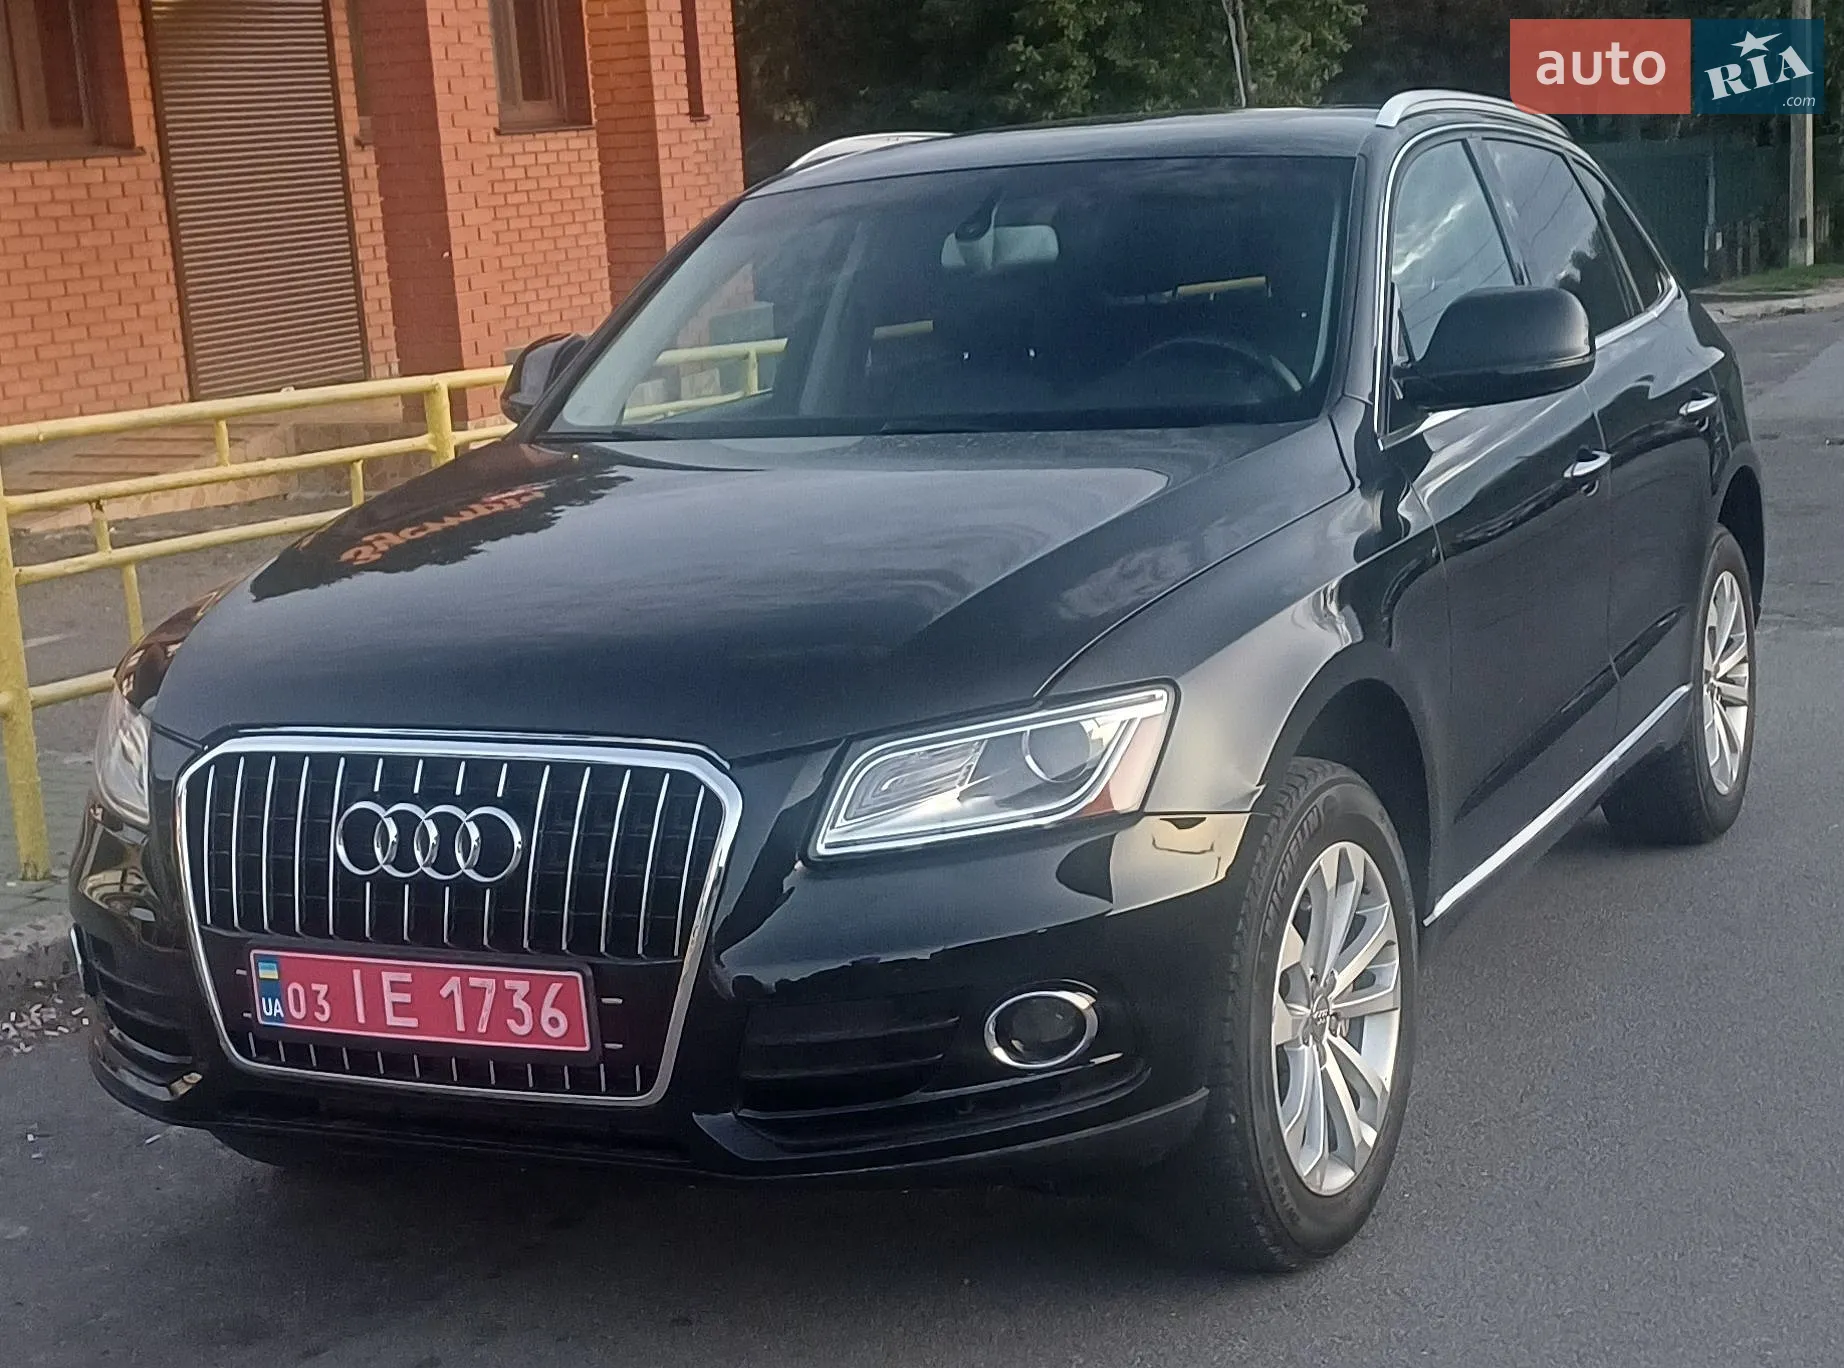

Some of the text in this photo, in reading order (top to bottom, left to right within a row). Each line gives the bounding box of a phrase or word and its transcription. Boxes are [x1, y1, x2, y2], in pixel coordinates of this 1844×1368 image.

[262, 996, 285, 1018] UA
[287, 982, 332, 1023] 03
[439, 976, 569, 1038] 1736
